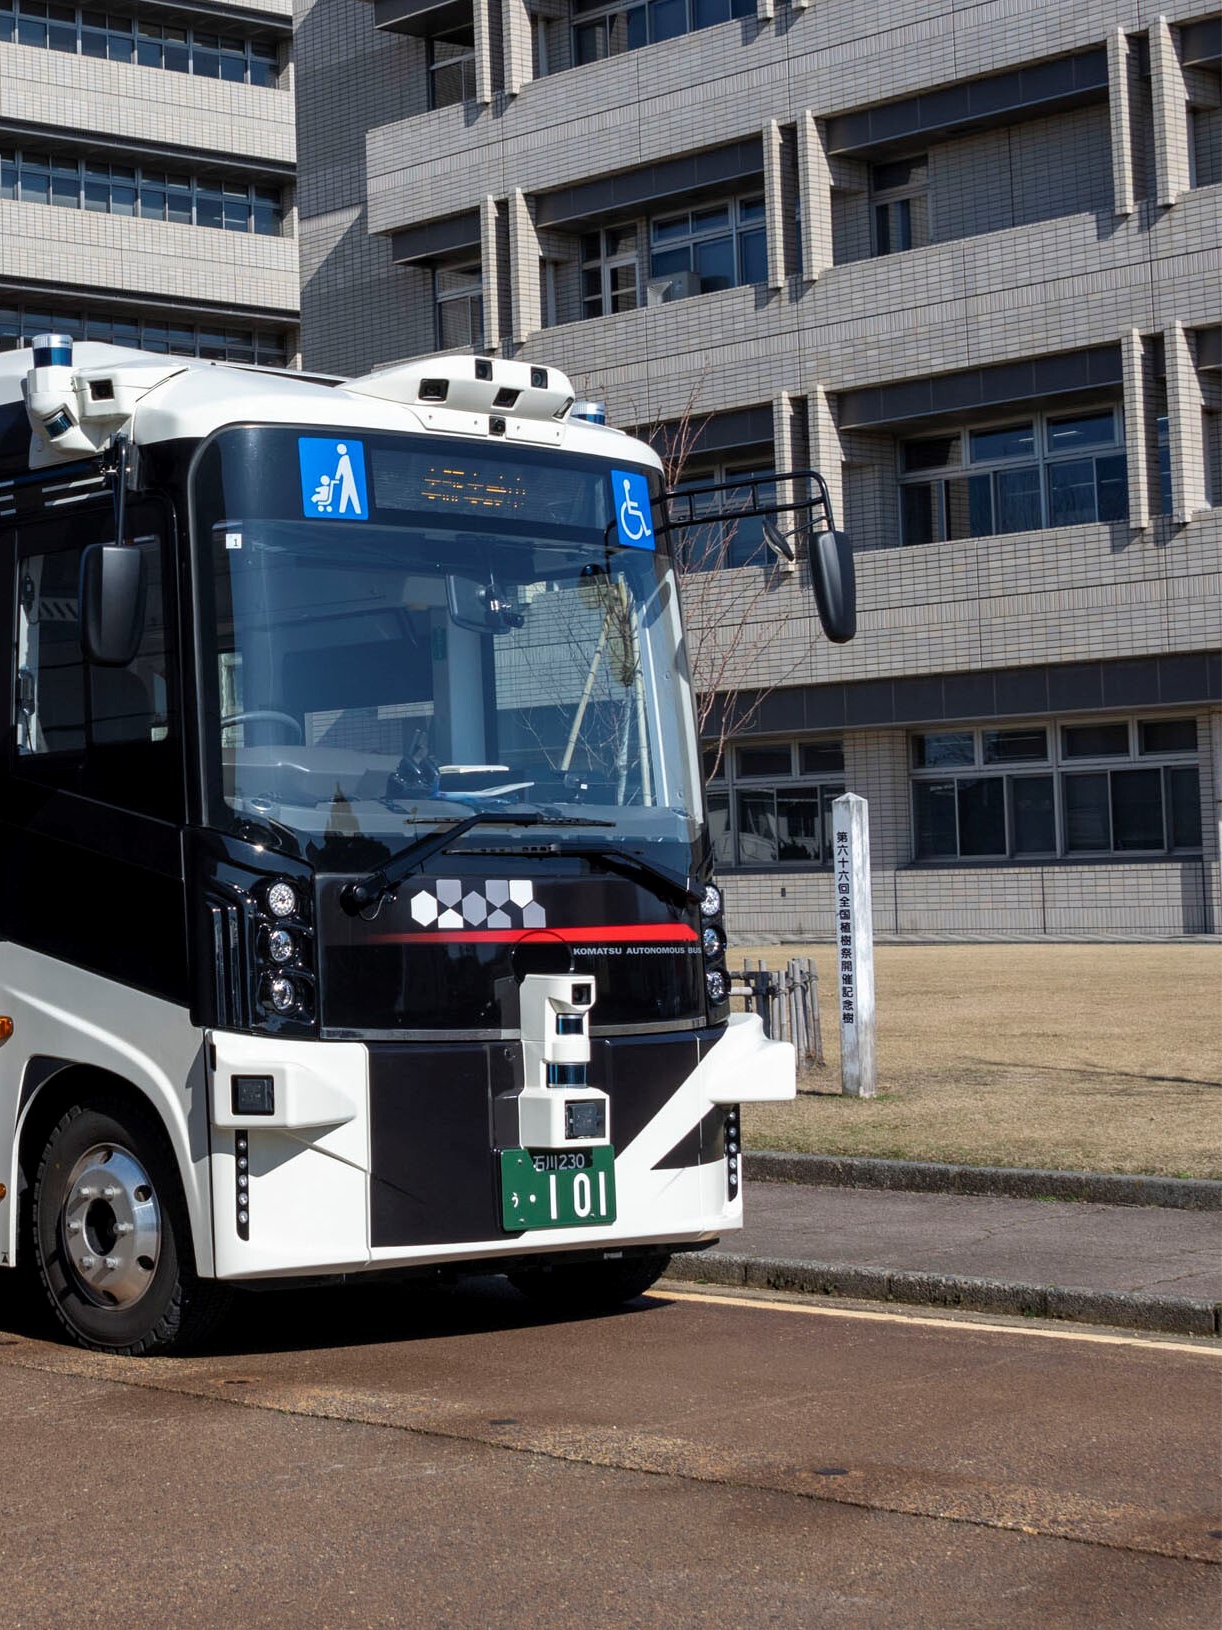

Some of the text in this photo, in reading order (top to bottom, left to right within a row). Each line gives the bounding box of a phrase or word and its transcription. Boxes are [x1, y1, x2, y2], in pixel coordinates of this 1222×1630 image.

[837, 831, 854, 1024] 第六十六回全国植樹祭開催記念樹
[573, 946, 702, 955] KOMATSU AUTONOMOUS BUS
[511, 1191, 519, 1208] う
